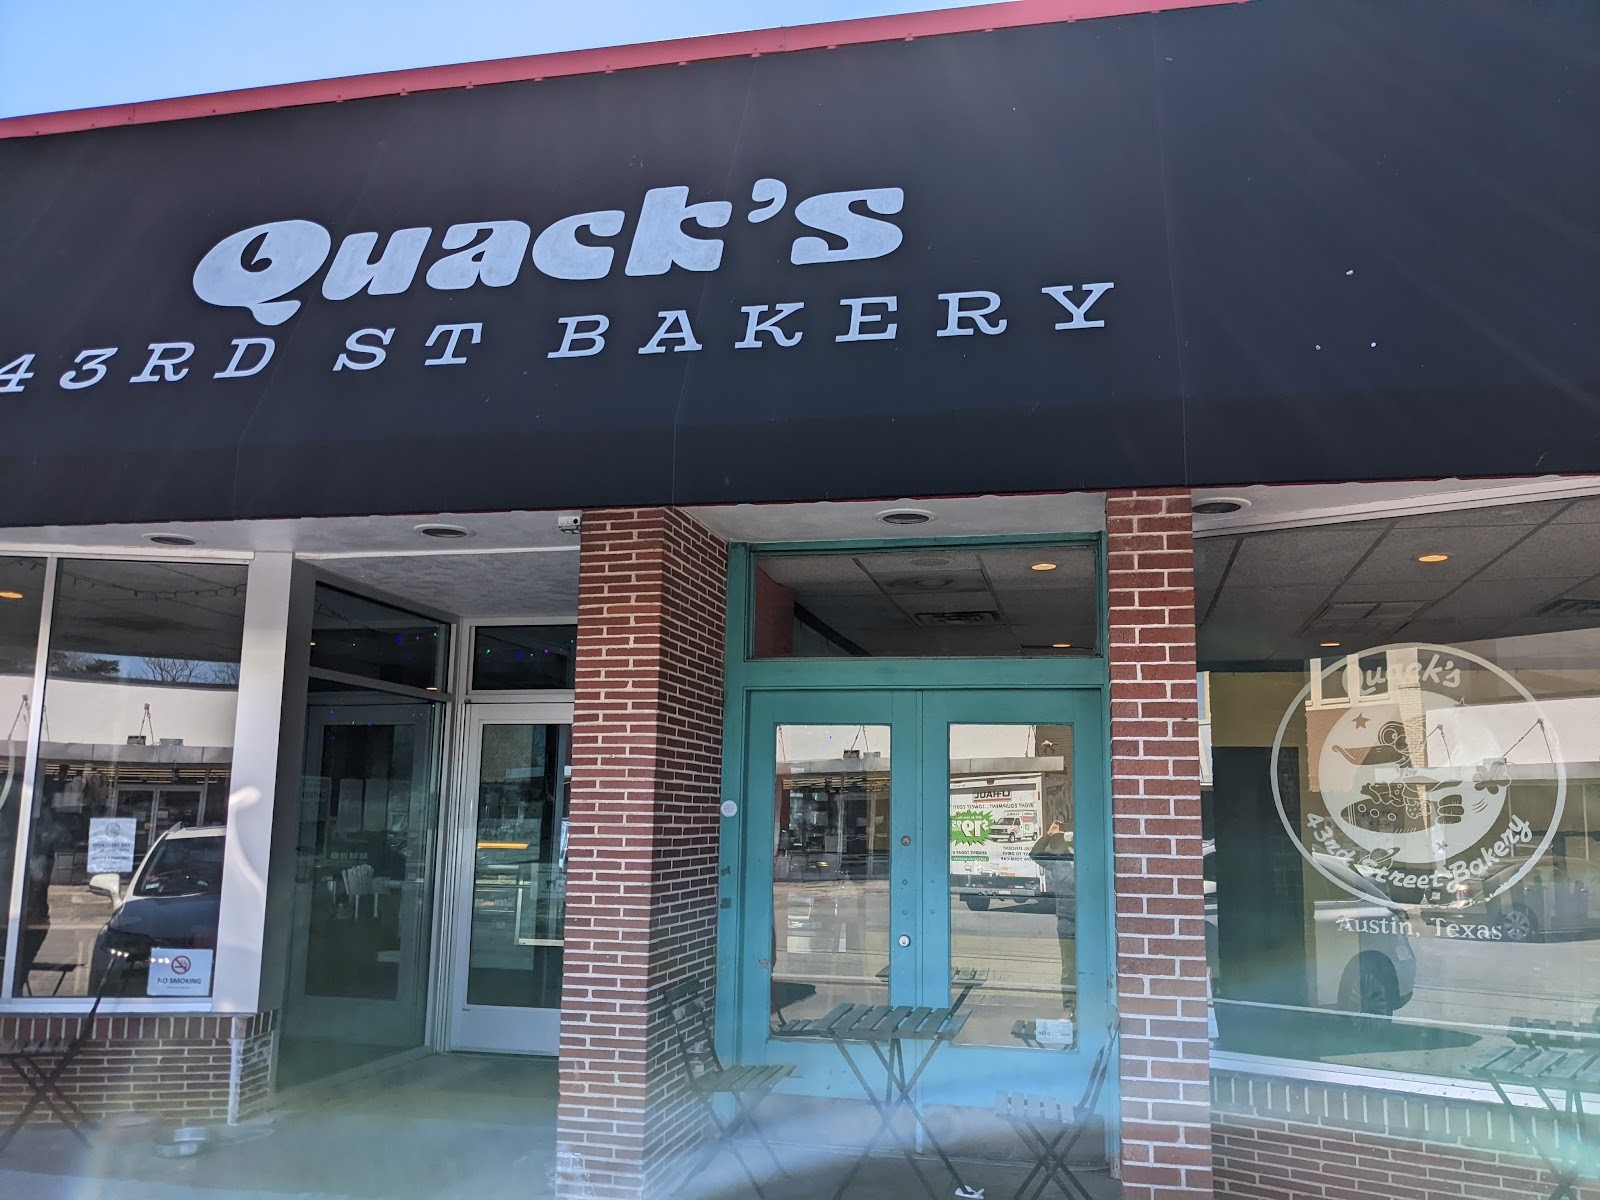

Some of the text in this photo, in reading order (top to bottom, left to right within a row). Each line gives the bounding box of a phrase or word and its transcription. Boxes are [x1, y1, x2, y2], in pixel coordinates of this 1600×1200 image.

[192, 177, 905, 327] Quack's
[0, 281, 1115, 394] 43RD ST BAKERY
[1341, 653, 1461, 695] Quack's
[1306, 812, 1533, 893] 43rd Street Bakery
[1336, 916, 1502, 940] Austin, Texas
